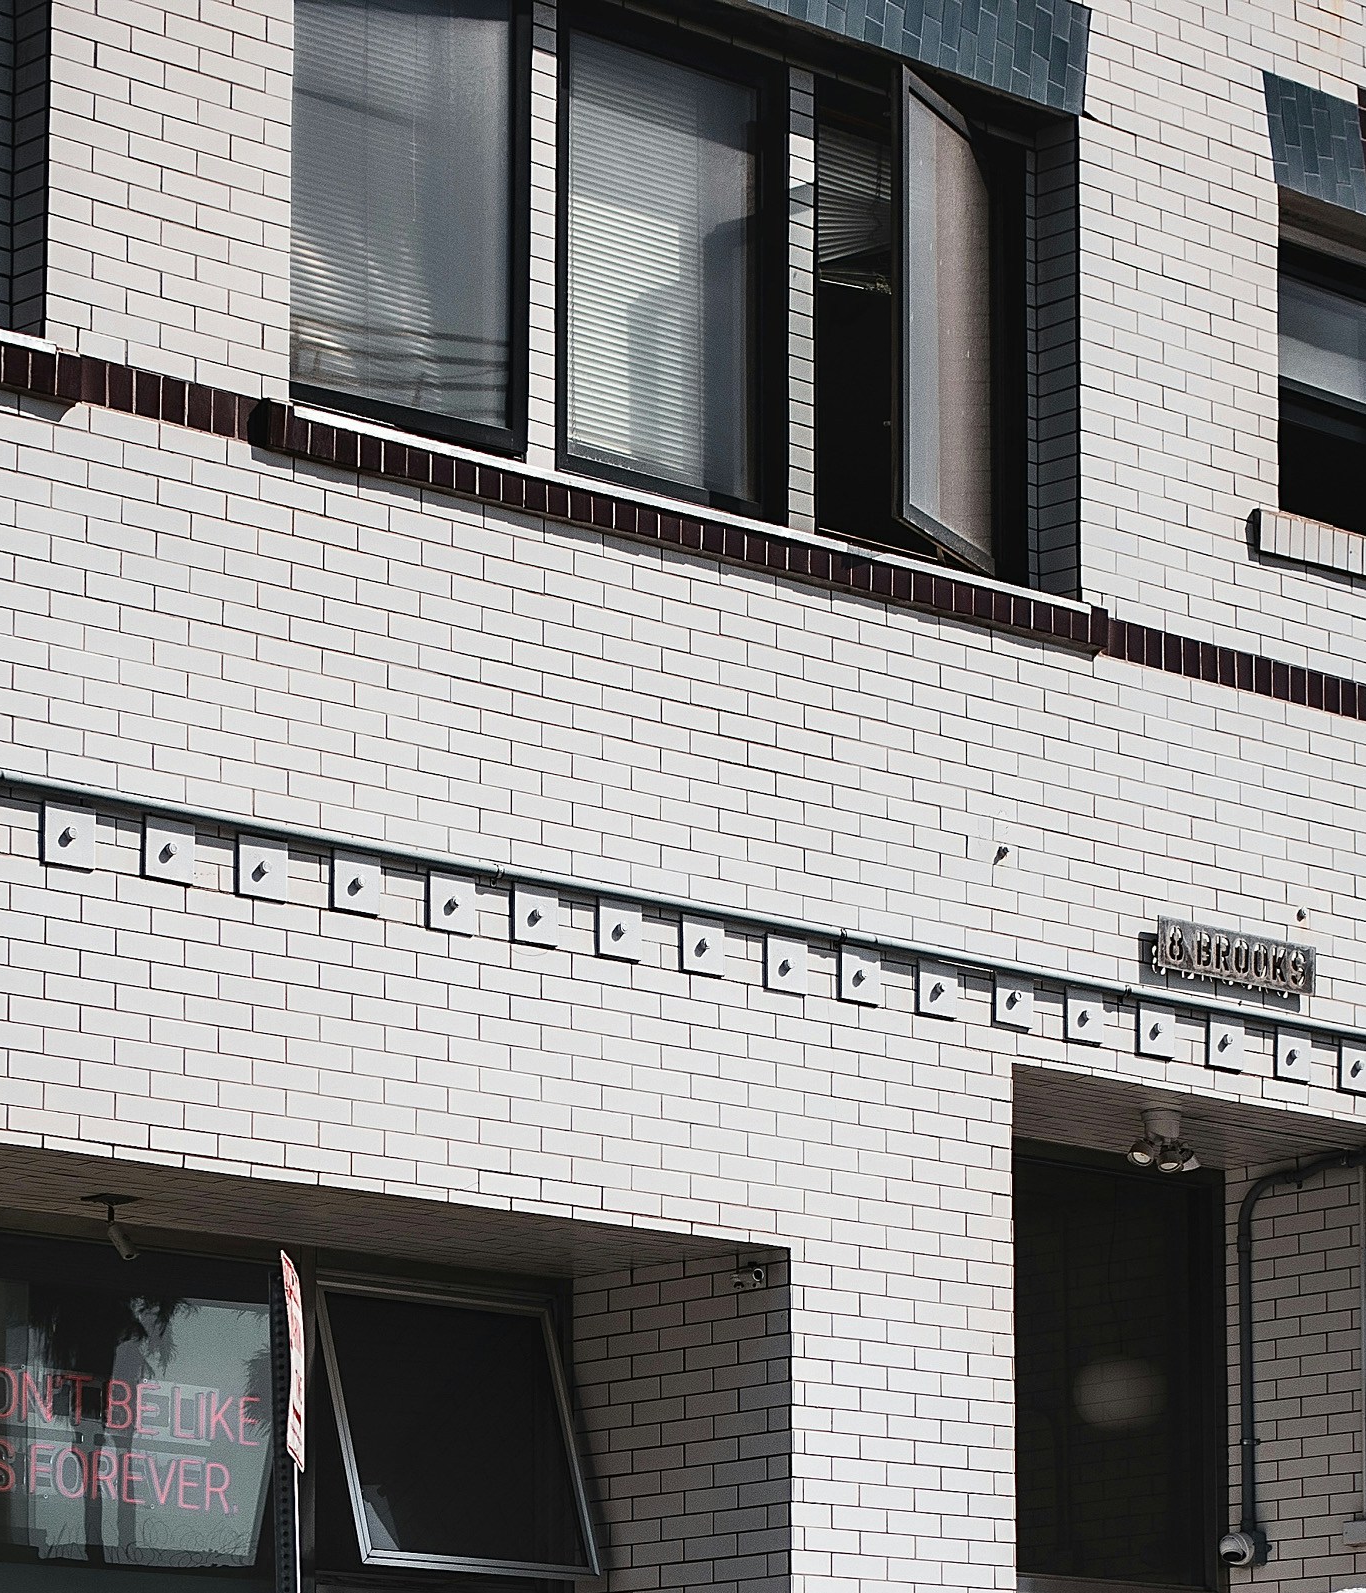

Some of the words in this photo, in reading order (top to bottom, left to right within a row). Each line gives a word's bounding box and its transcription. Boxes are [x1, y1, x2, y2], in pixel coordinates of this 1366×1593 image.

[1168, 925, 1184, 961] 8
[1196, 930, 1307, 987] BROOKS
[105, 1378, 161, 1437] BE
[171, 1385, 261, 1447] LIKE
[29, 1444, 239, 1516] FOREVER.
